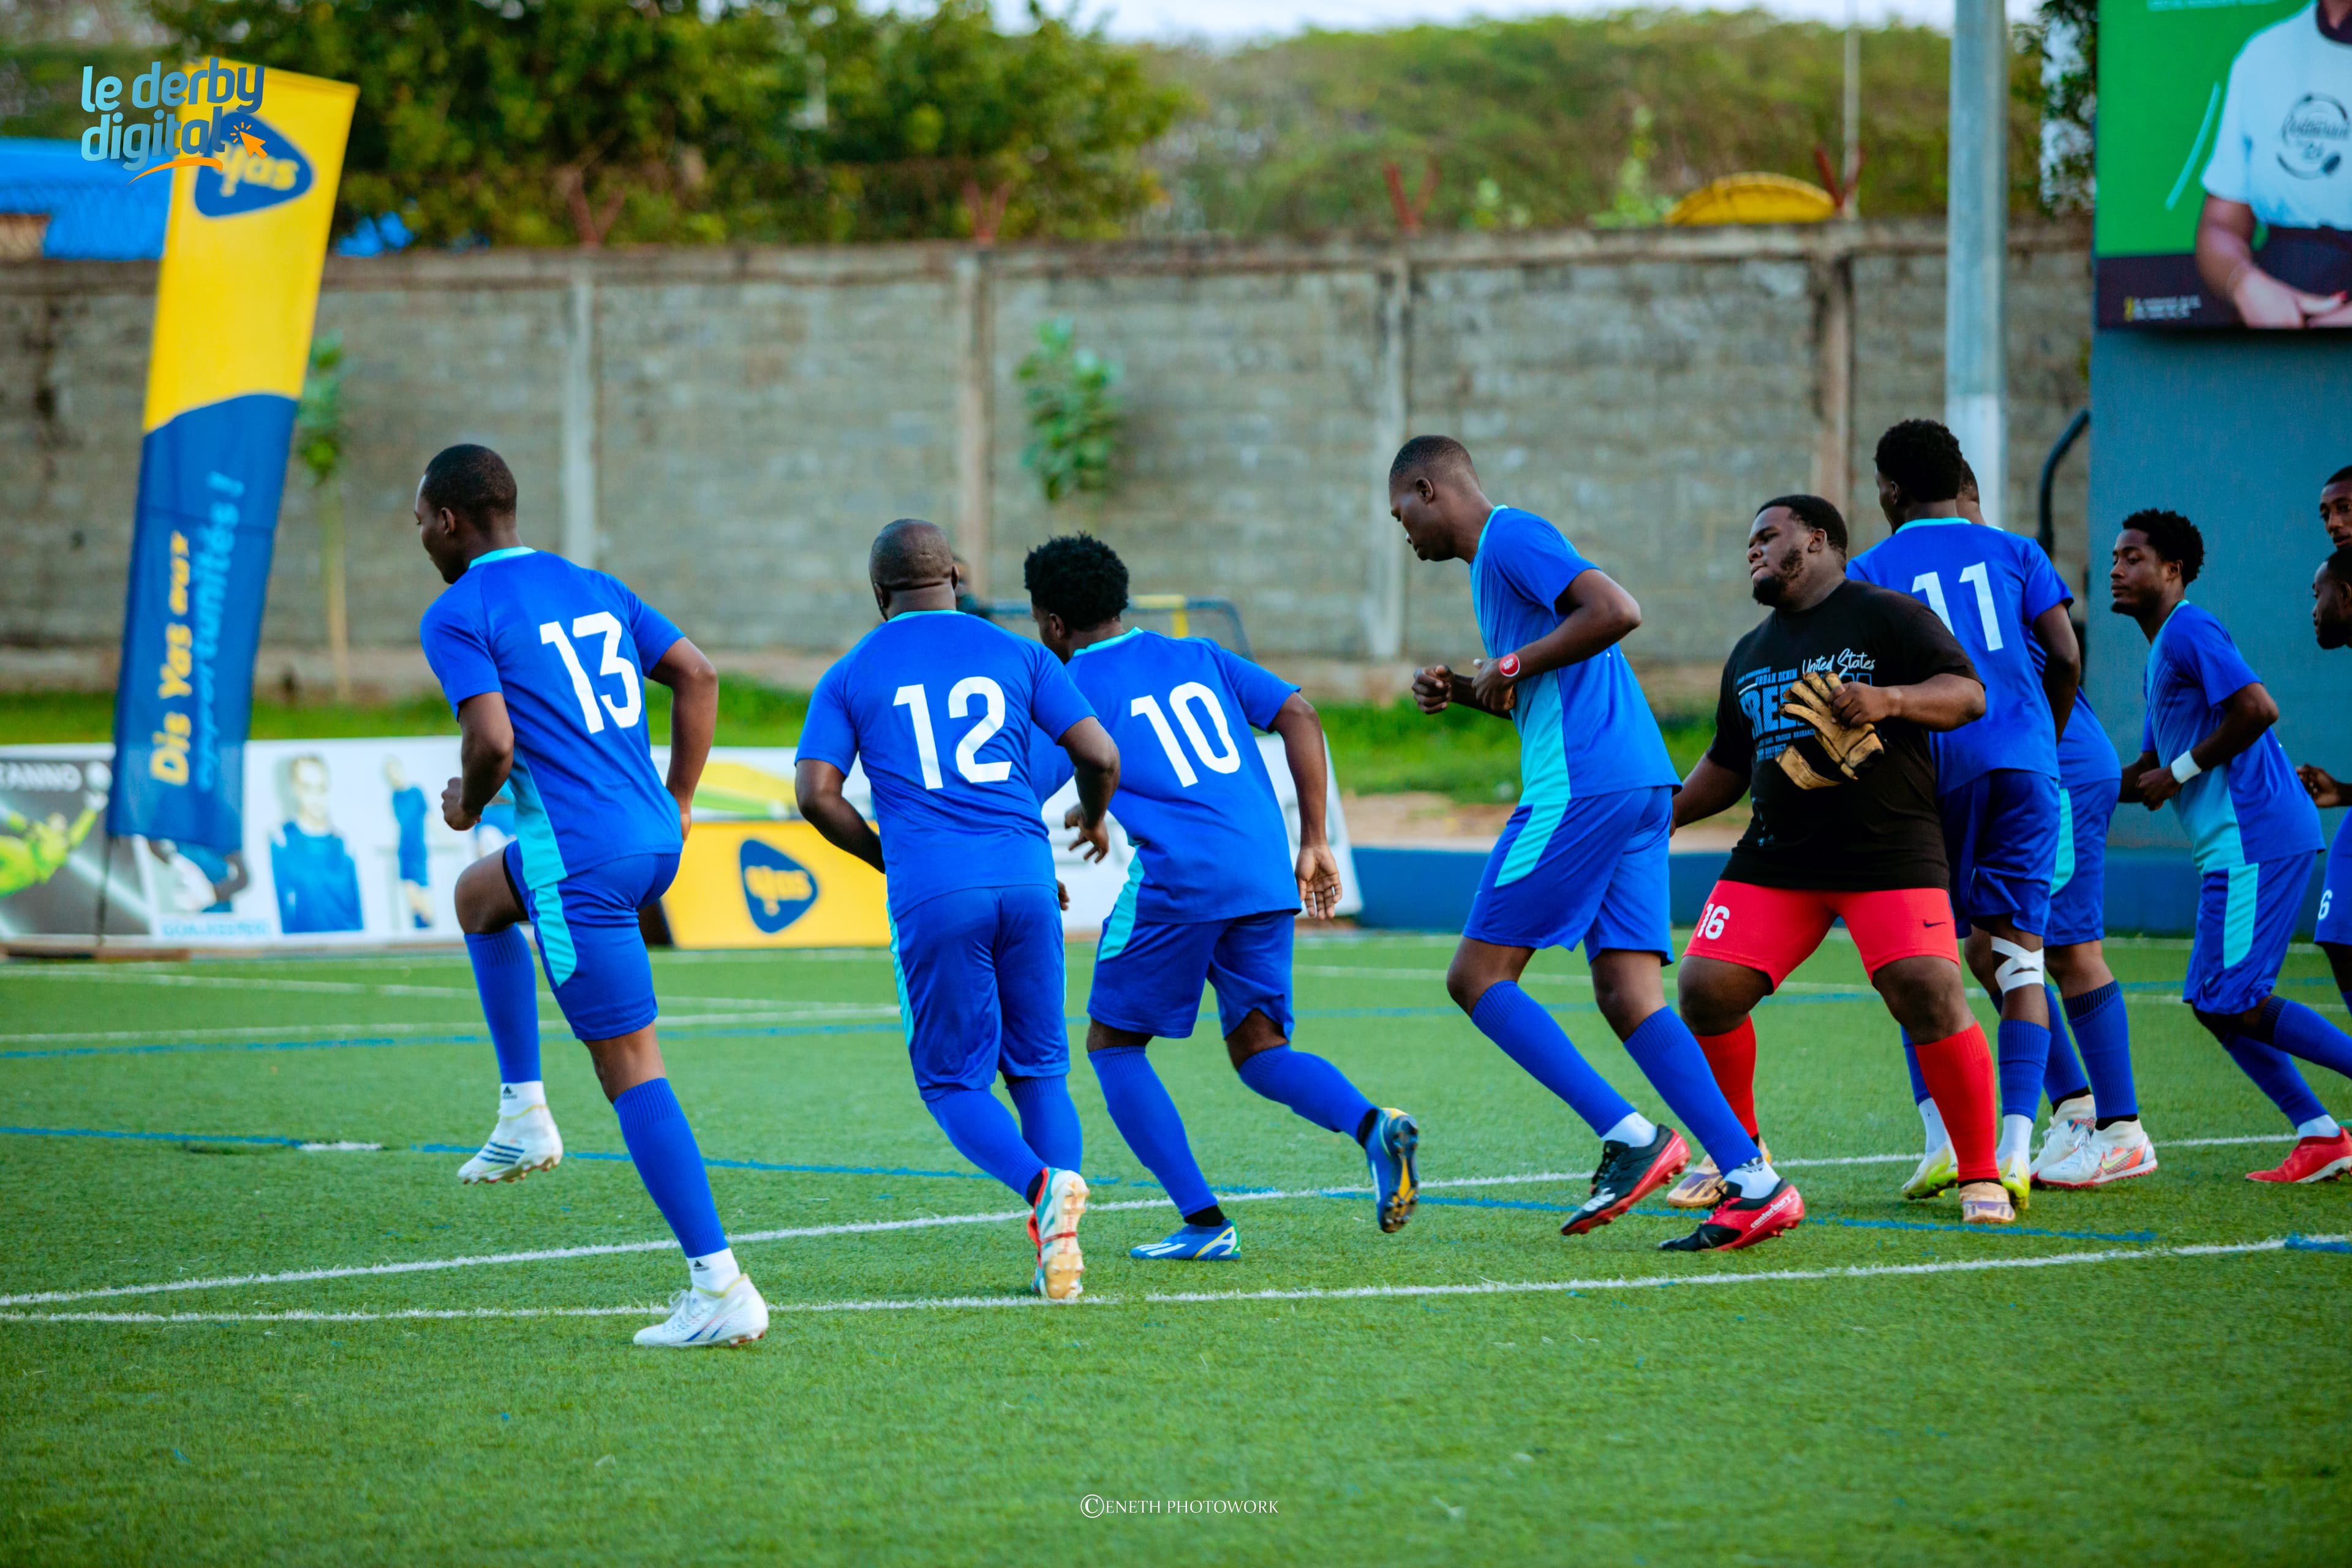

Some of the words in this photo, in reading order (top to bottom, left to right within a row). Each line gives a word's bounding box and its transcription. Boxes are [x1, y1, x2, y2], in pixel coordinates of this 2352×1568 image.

[1911, 562, 2003, 652] 11
[158, 623, 192, 699] Yas
[540, 611, 642, 734] 13
[1755, 673, 1776, 686] URBAN
[1778, 668, 1798, 683] DENIM
[1802, 654, 1835, 674] United
[1838, 648, 1875, 679] States
[149, 711, 192, 785] Dis
[893, 676, 1012, 790] 12
[1131, 681, 1241, 788] 10
[1697, 902, 1730, 940] 16
